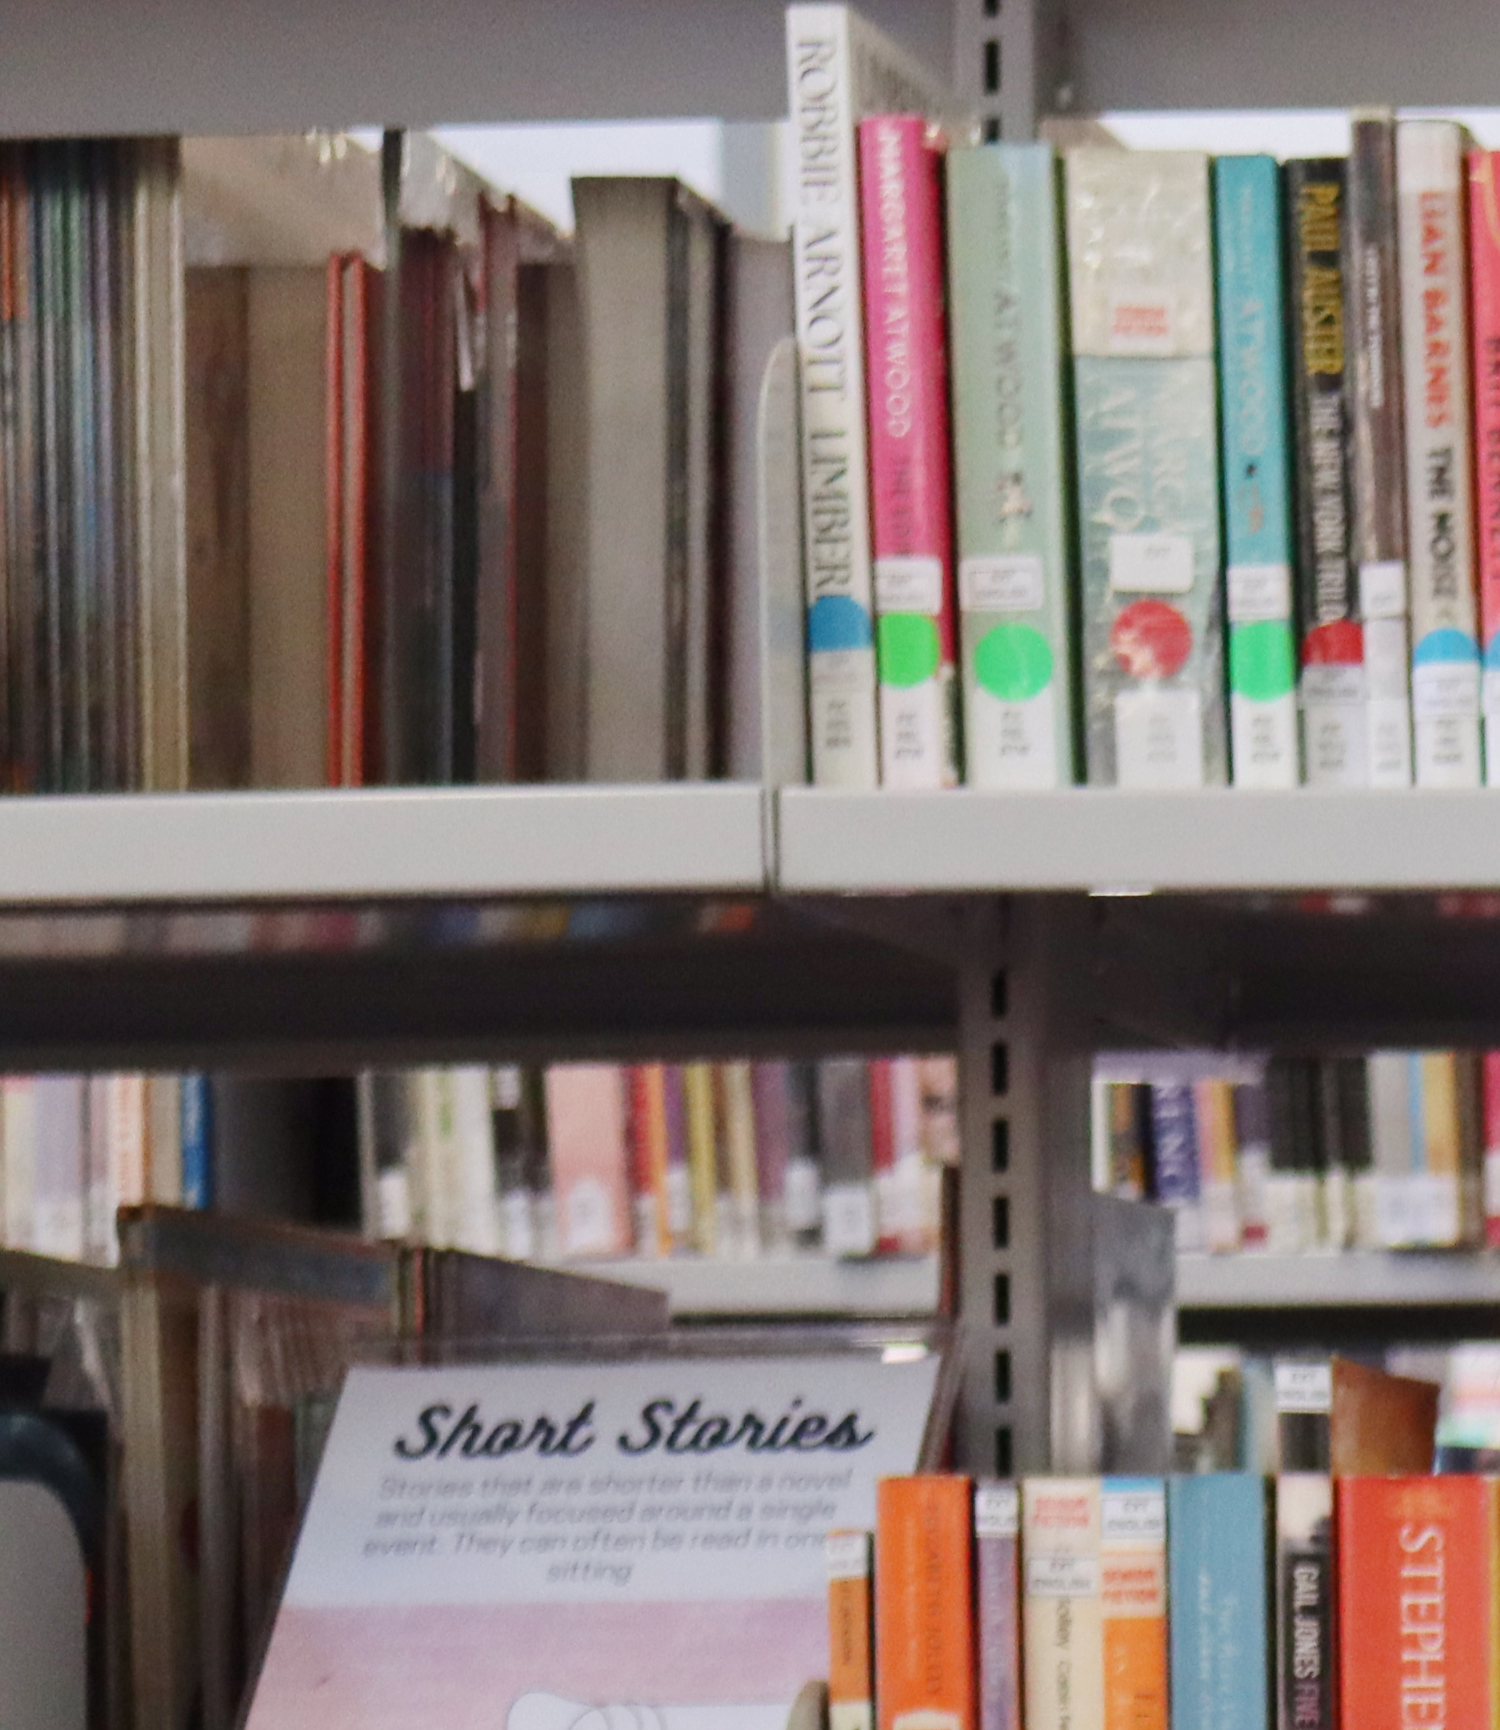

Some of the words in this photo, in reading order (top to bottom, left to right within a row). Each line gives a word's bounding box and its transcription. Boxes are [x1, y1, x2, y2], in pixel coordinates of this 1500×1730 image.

[798, 40, 842, 205] ROBBIE
[879, 133, 910, 294] MARGARET
[1301, 183, 1340, 252] PAUL
[804, 222, 848, 399] ARNOTT
[1305, 266, 1345, 376] AUSTER
[885, 306, 912, 439] ATWOOD
[1422, 287, 1455, 430] BARNES
[1426, 445, 1456, 501] THE
[808, 429, 854, 588] LIMBER
[394, 1398, 597, 1461] Short
[616, 1392, 876, 1456] Stories
[375, 1506, 425, 1530] and
[428, 1501, 521, 1533] usually
[526, 1499, 632, 1526] focused
[637, 1499, 733, 1523] around
[757, 1498, 838, 1526] single
[380, 1474, 474, 1501] Stories
[479, 1472, 532, 1498] that
[538, 1476, 587, 1497] are
[588, 1470, 686, 1496] shorter
[688, 1470, 753, 1492] than
[778, 1466, 854, 1491] novel
[452, 1530, 515, 1561] They
[517, 1532, 570, 1553] can
[573, 1527, 648, 1551] often
[649, 1528, 683, 1551] be
[685, 1526, 749, 1551] read
[752, 1528, 780, 1549] in
[544, 1561, 636, 1589] sitting
[1293, 1564, 1320, 1610] GAIL
[1294, 1615, 1320, 1679] JONES
